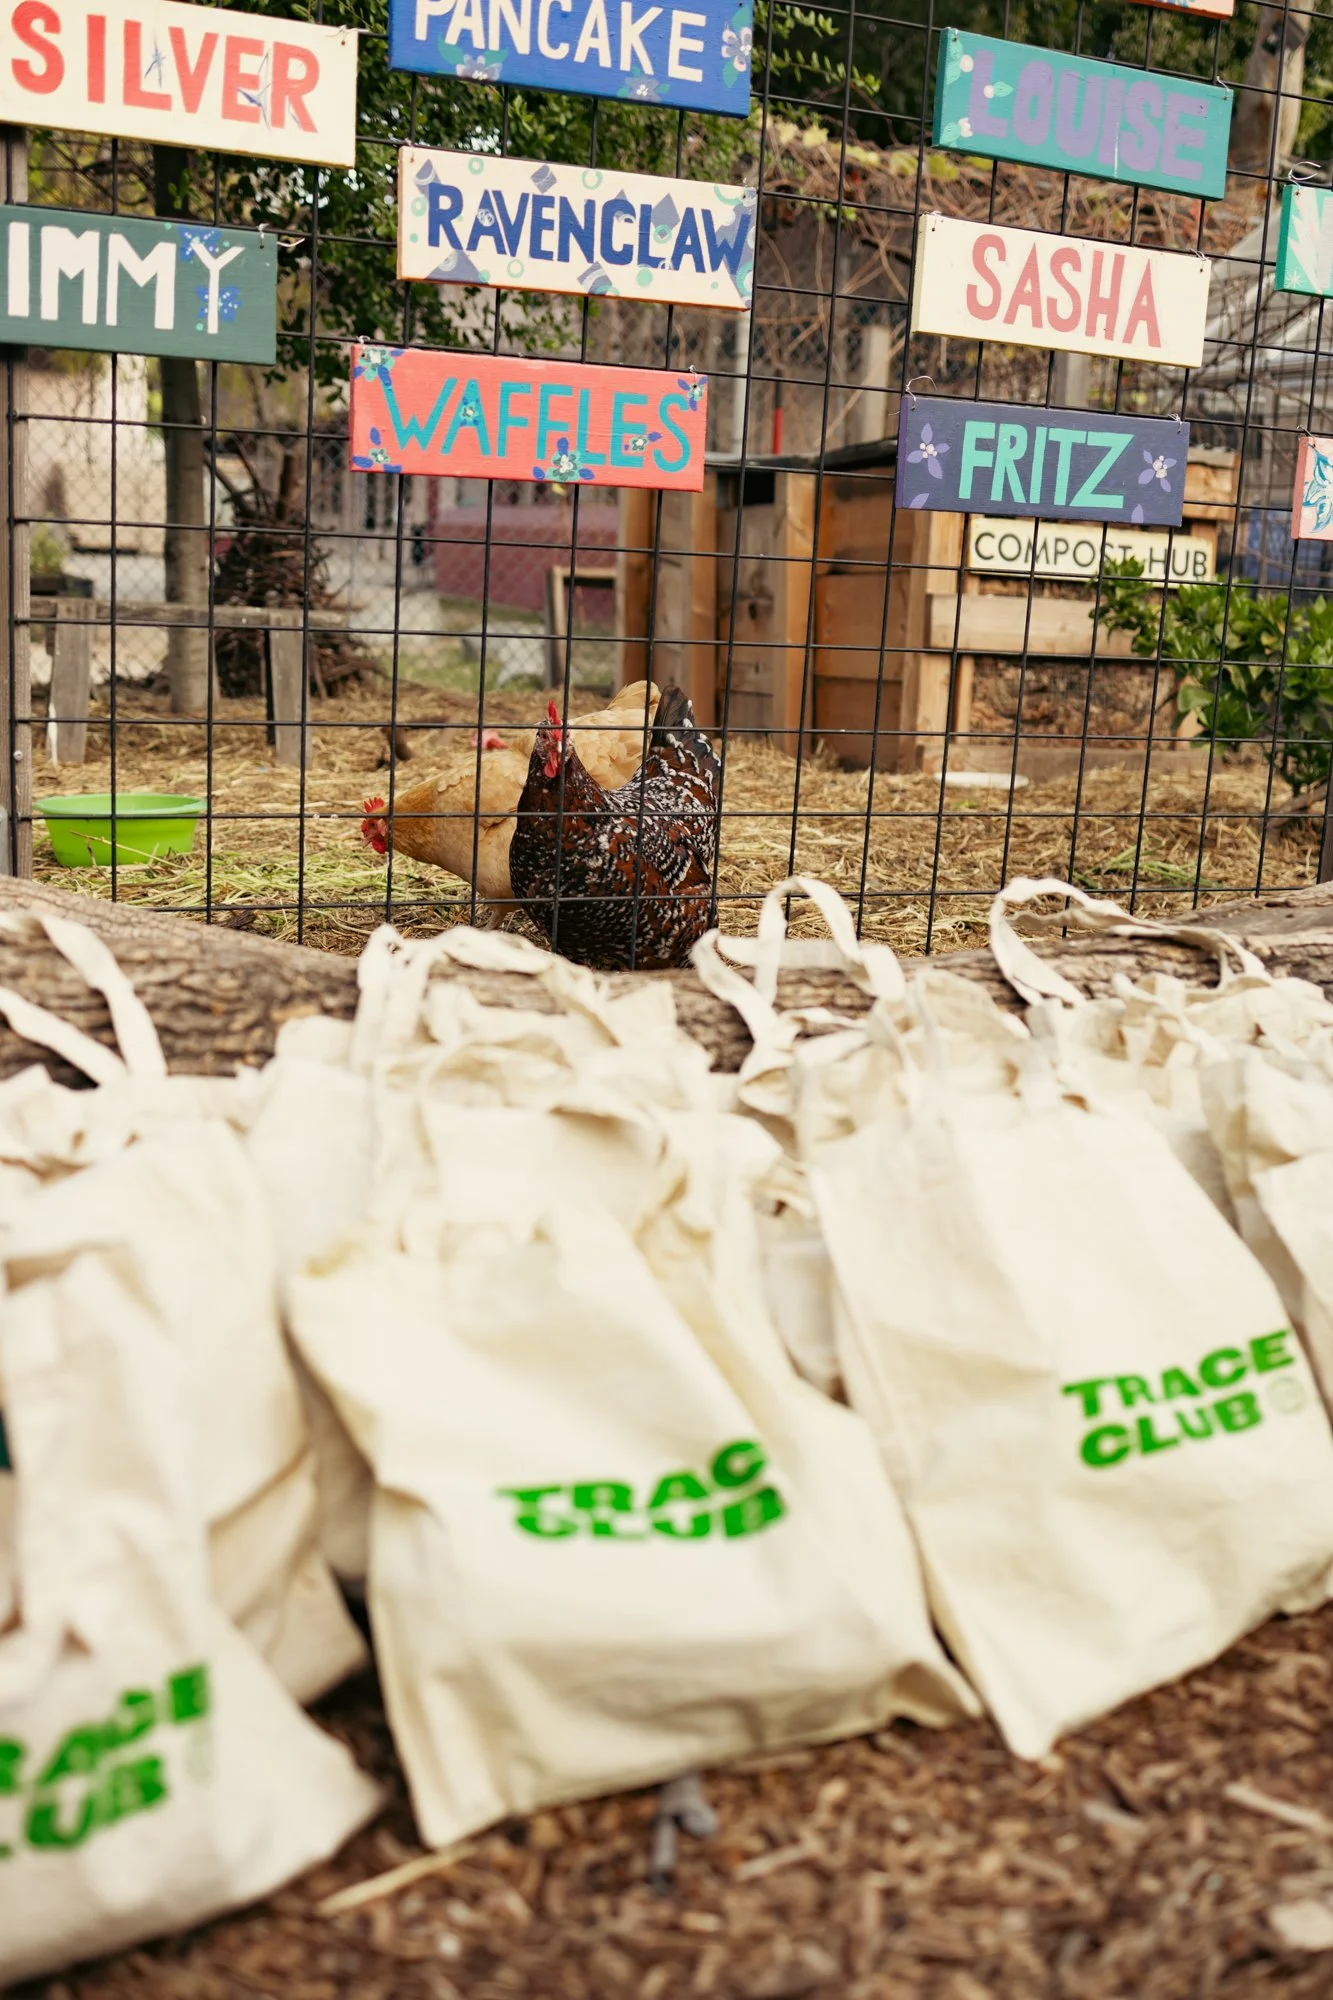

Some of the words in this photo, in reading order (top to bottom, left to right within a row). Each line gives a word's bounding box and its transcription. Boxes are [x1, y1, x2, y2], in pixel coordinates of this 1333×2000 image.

[11, 0, 319, 134] SILVER
[415, 0, 707, 83] PANCAKE
[967, 49, 1210, 181] LOUISE
[427, 182, 751, 276] RAVENCLAW
[8, 221, 246, 335] IMMY
[966, 234, 1162, 348] SASHA
[379, 377, 692, 473] WAFFLES
[958, 420, 1134, 509] FRITZ
[974, 531, 1133, 572] COMPOST
[1148, 546, 1208, 578] HUB
[1060, 1328, 1295, 1418] TRACE
[1079, 1391, 1263, 1469] CLUB
